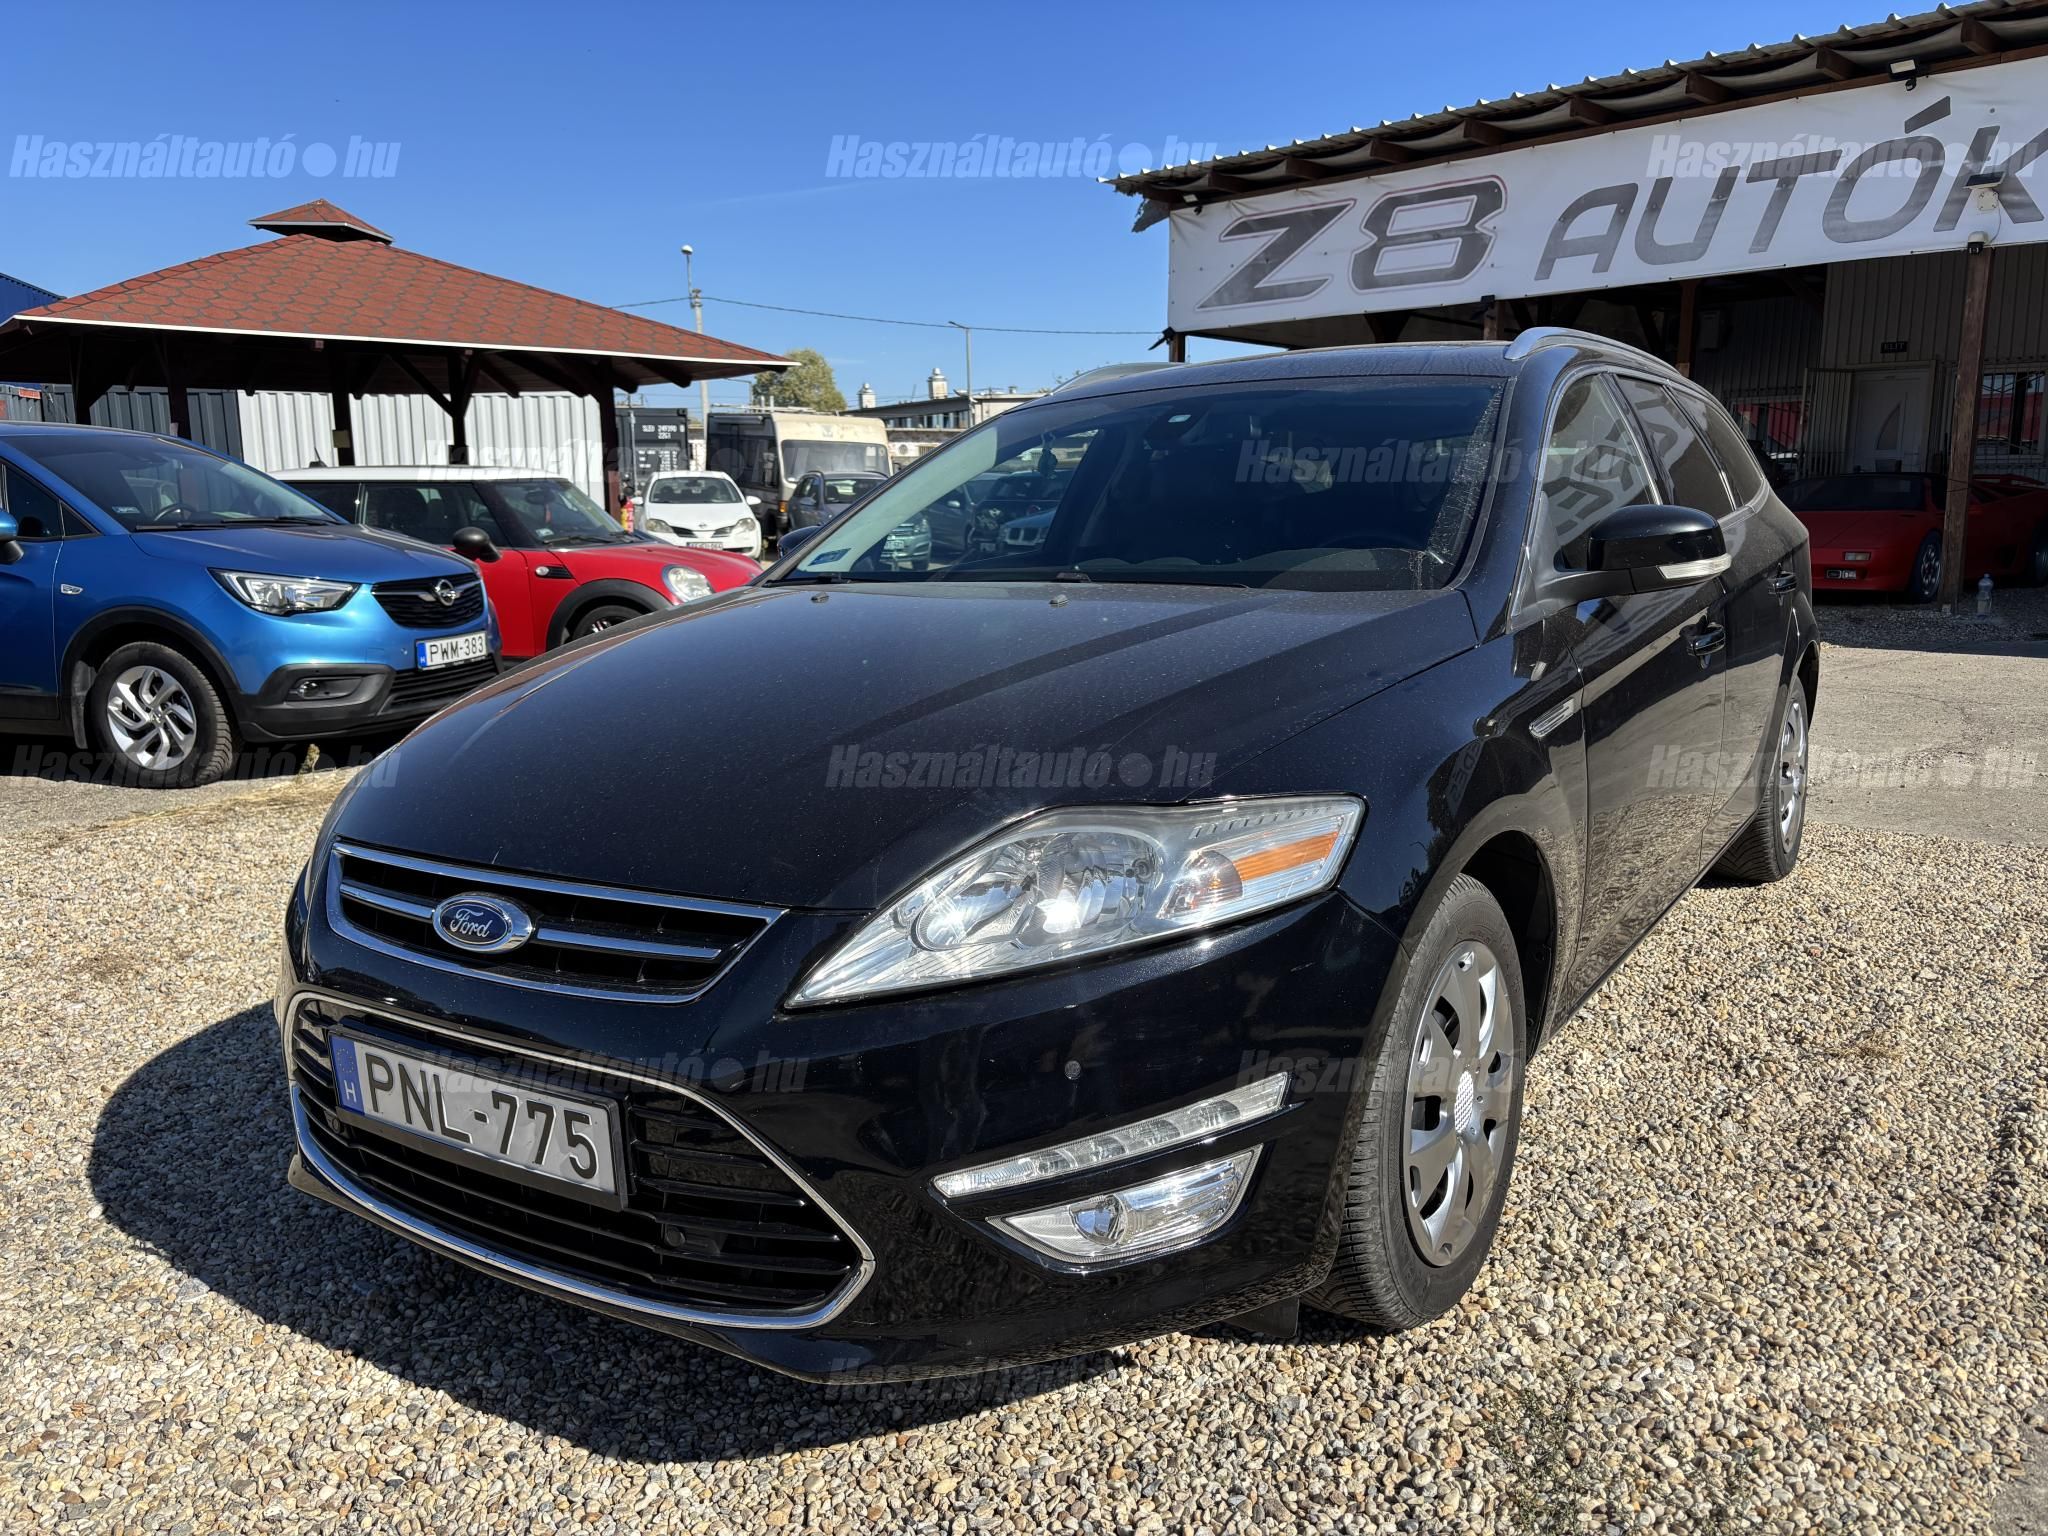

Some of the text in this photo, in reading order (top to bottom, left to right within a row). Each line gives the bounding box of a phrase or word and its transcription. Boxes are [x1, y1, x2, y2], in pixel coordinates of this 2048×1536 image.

[1197, 96, 2048, 312] Z8 AUTÓK
[429, 636, 484, 663] PWM-383
[447, 907, 491, 940] Ford
[364, 1053, 599, 1181] PNL-775
